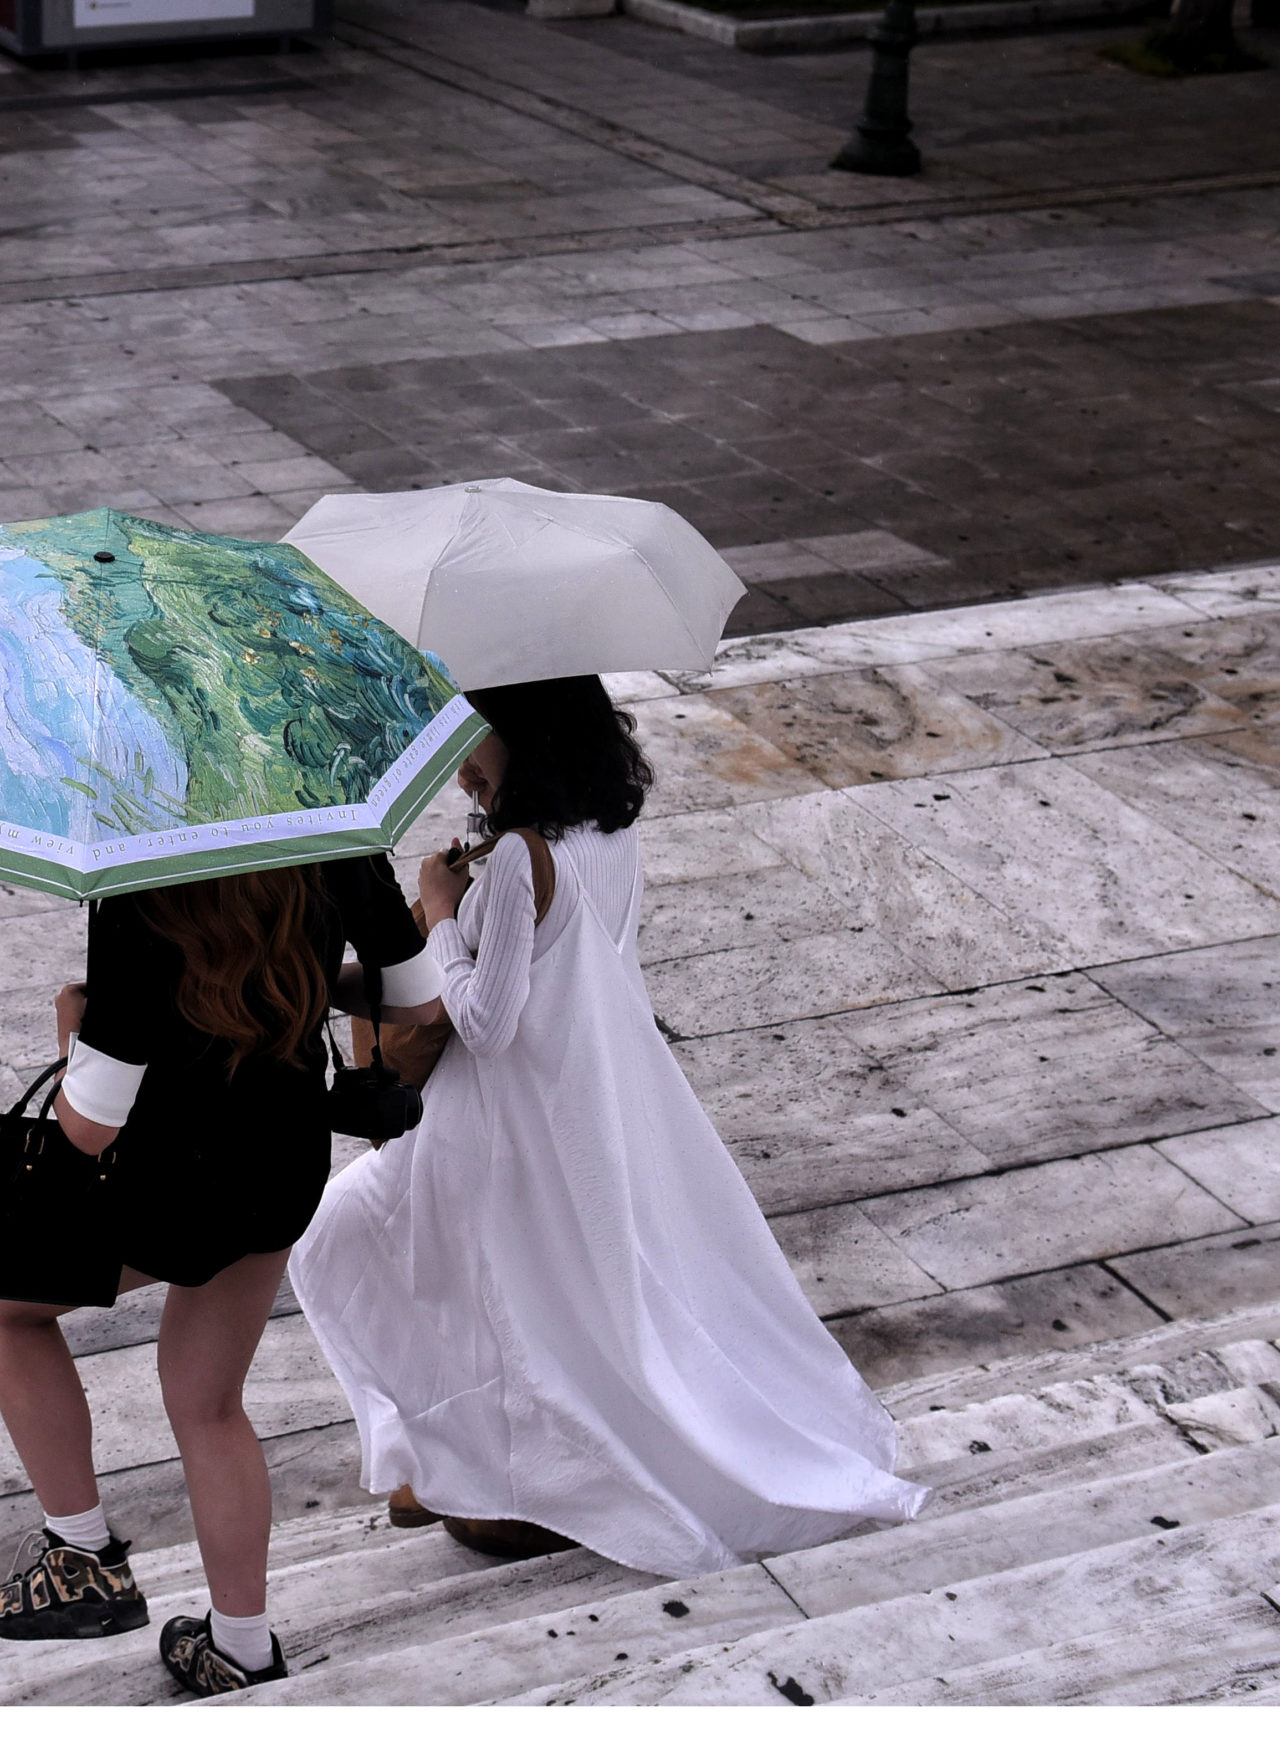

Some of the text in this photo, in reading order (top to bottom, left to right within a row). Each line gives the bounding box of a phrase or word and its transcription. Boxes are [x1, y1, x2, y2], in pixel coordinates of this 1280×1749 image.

[420, 725, 440, 748] little
[402, 744, 419, 768] gate
[392, 767, 402, 784] of
[371, 776, 393, 808] green
[241, 816, 274, 833] you
[286, 808, 356, 827] Invites
[138, 830, 199, 849] enter,
[211, 825, 229, 838] to
[30, 834, 74, 856] view
[92, 843, 126, 861] and
